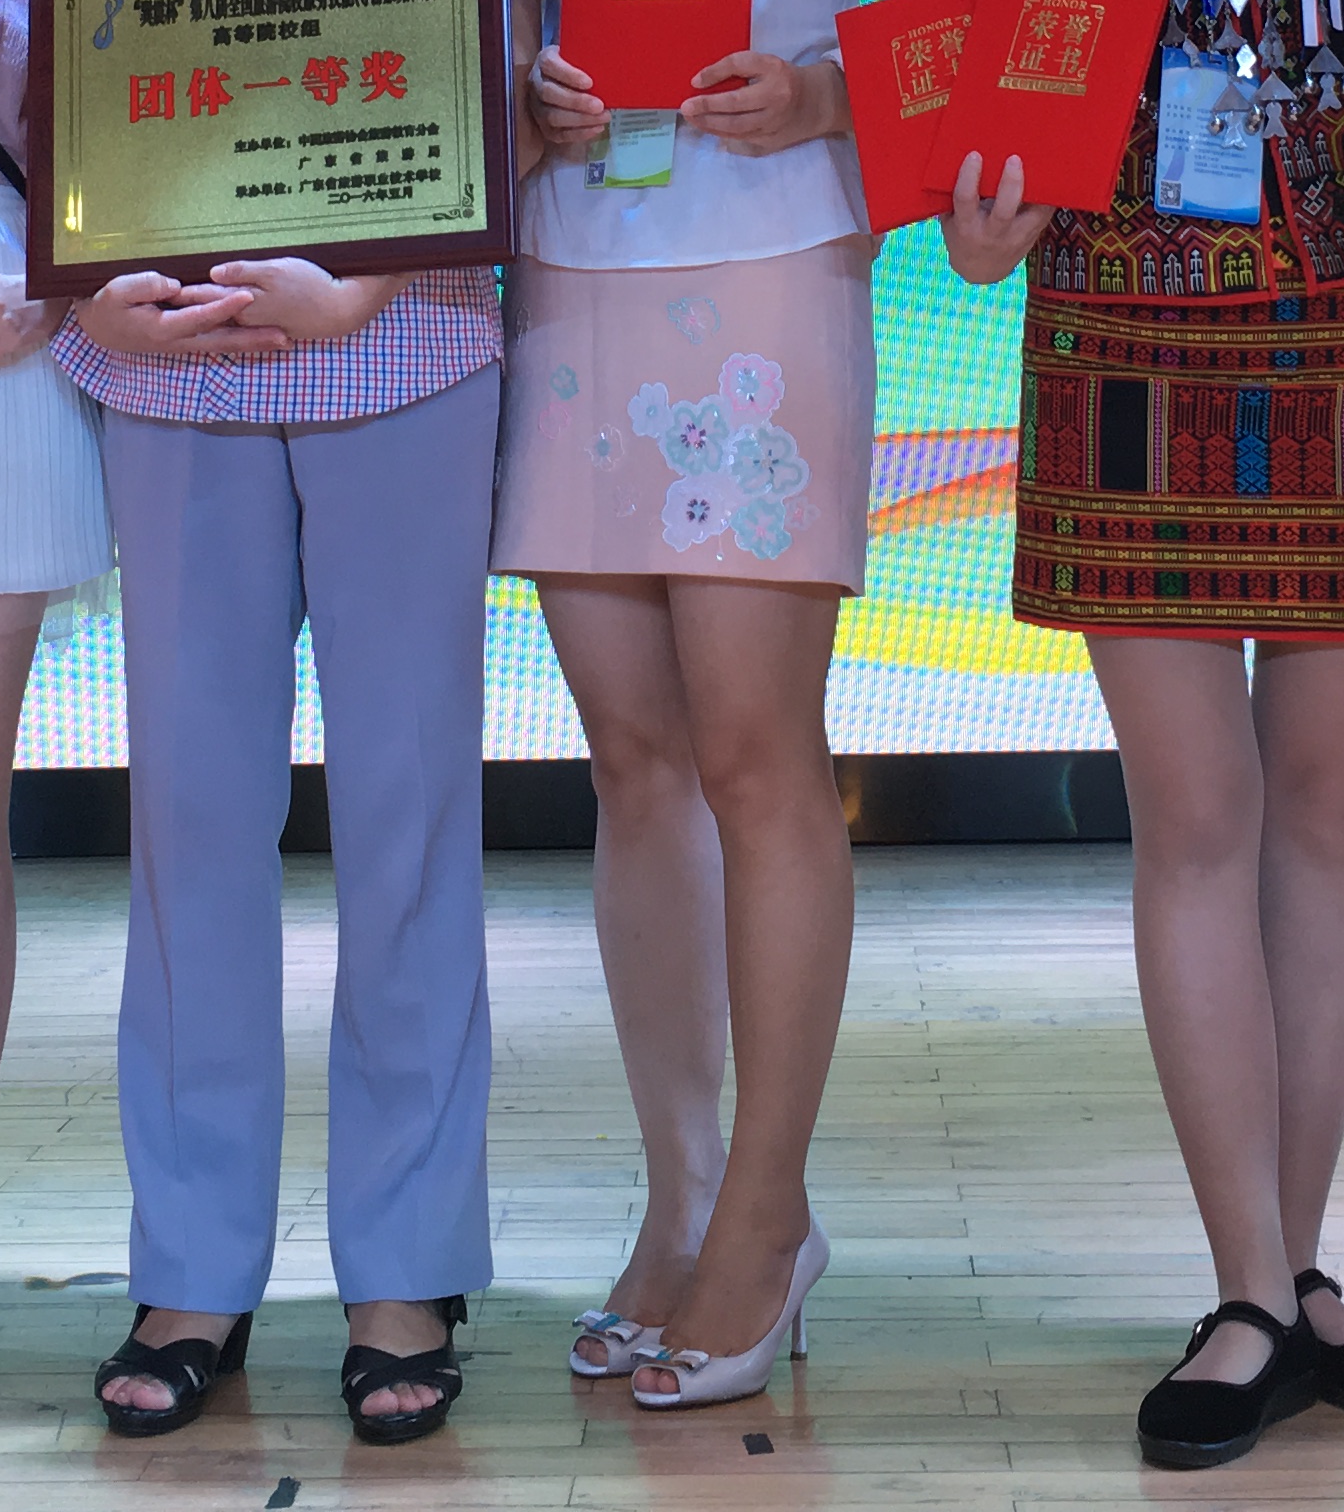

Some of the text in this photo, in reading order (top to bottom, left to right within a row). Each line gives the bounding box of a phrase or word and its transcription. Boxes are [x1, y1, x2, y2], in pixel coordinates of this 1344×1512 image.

[129, 50, 410, 123] 团体一等奖
